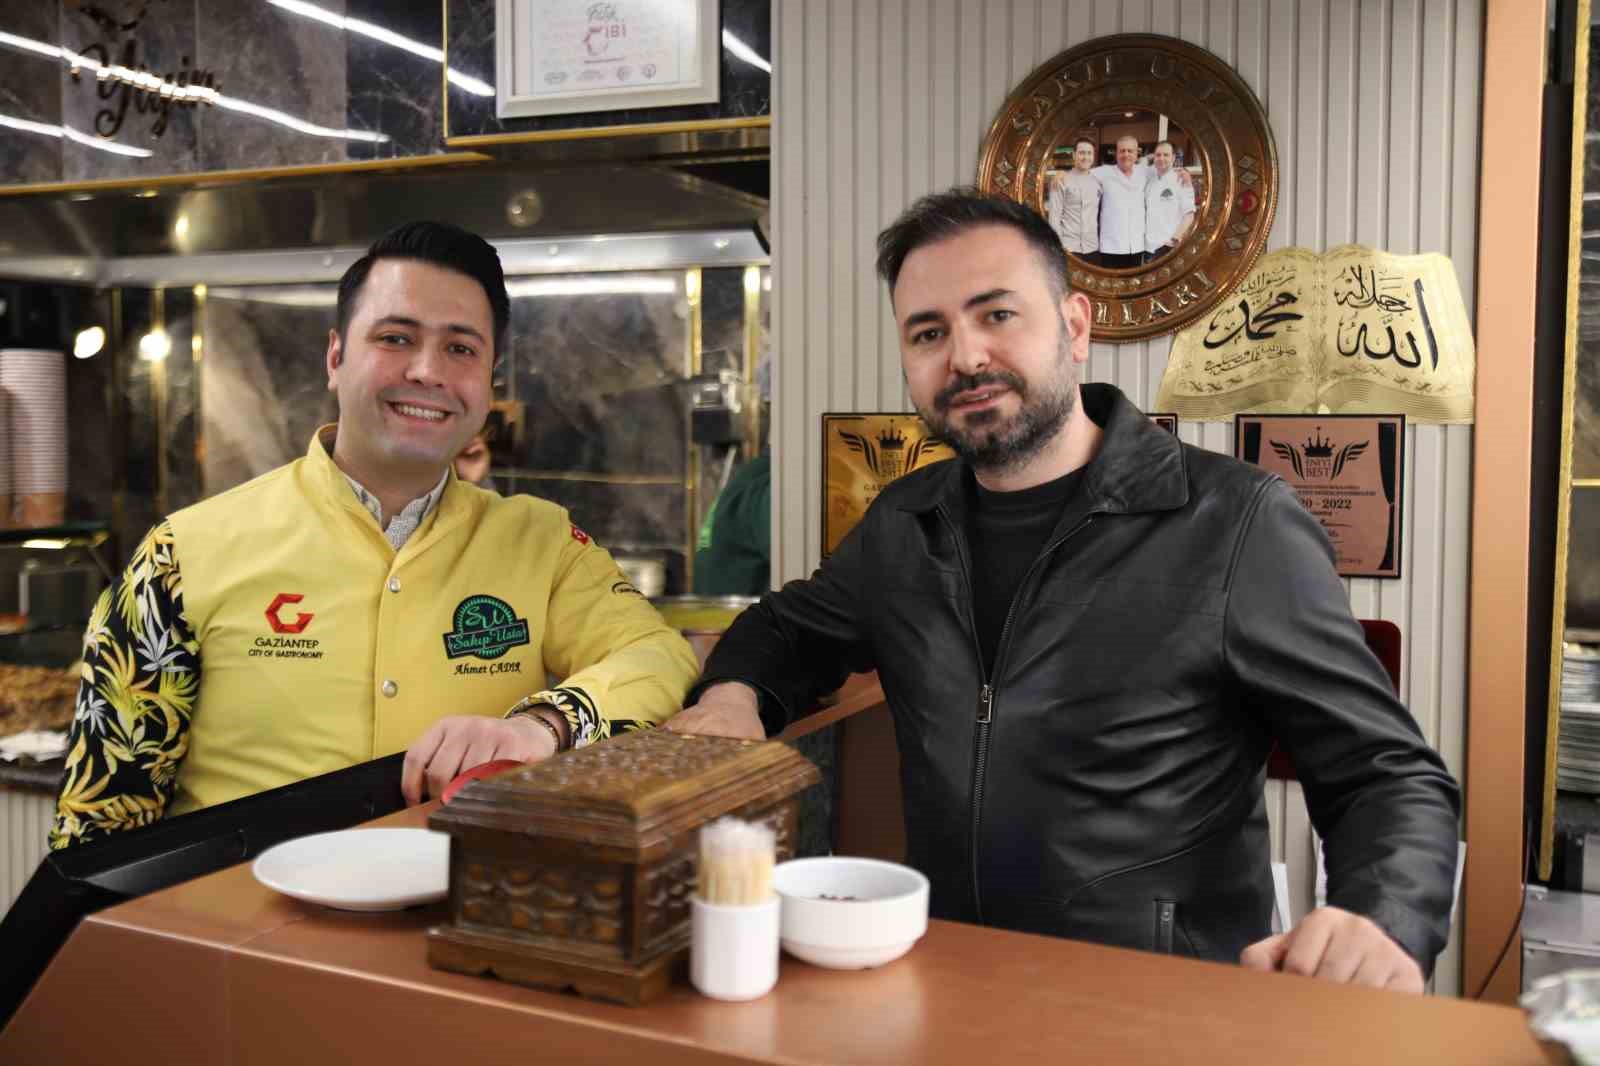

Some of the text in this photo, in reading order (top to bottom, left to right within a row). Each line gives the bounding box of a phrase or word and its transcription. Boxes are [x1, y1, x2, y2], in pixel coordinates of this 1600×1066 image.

[1321, 498, 1352, 510] 2022
[254, 636, 320, 649] GAZİANTEP
[248, 648, 323, 659] CITY OF GASTRONOMY
[454, 663, 487, 675] Ahmet
